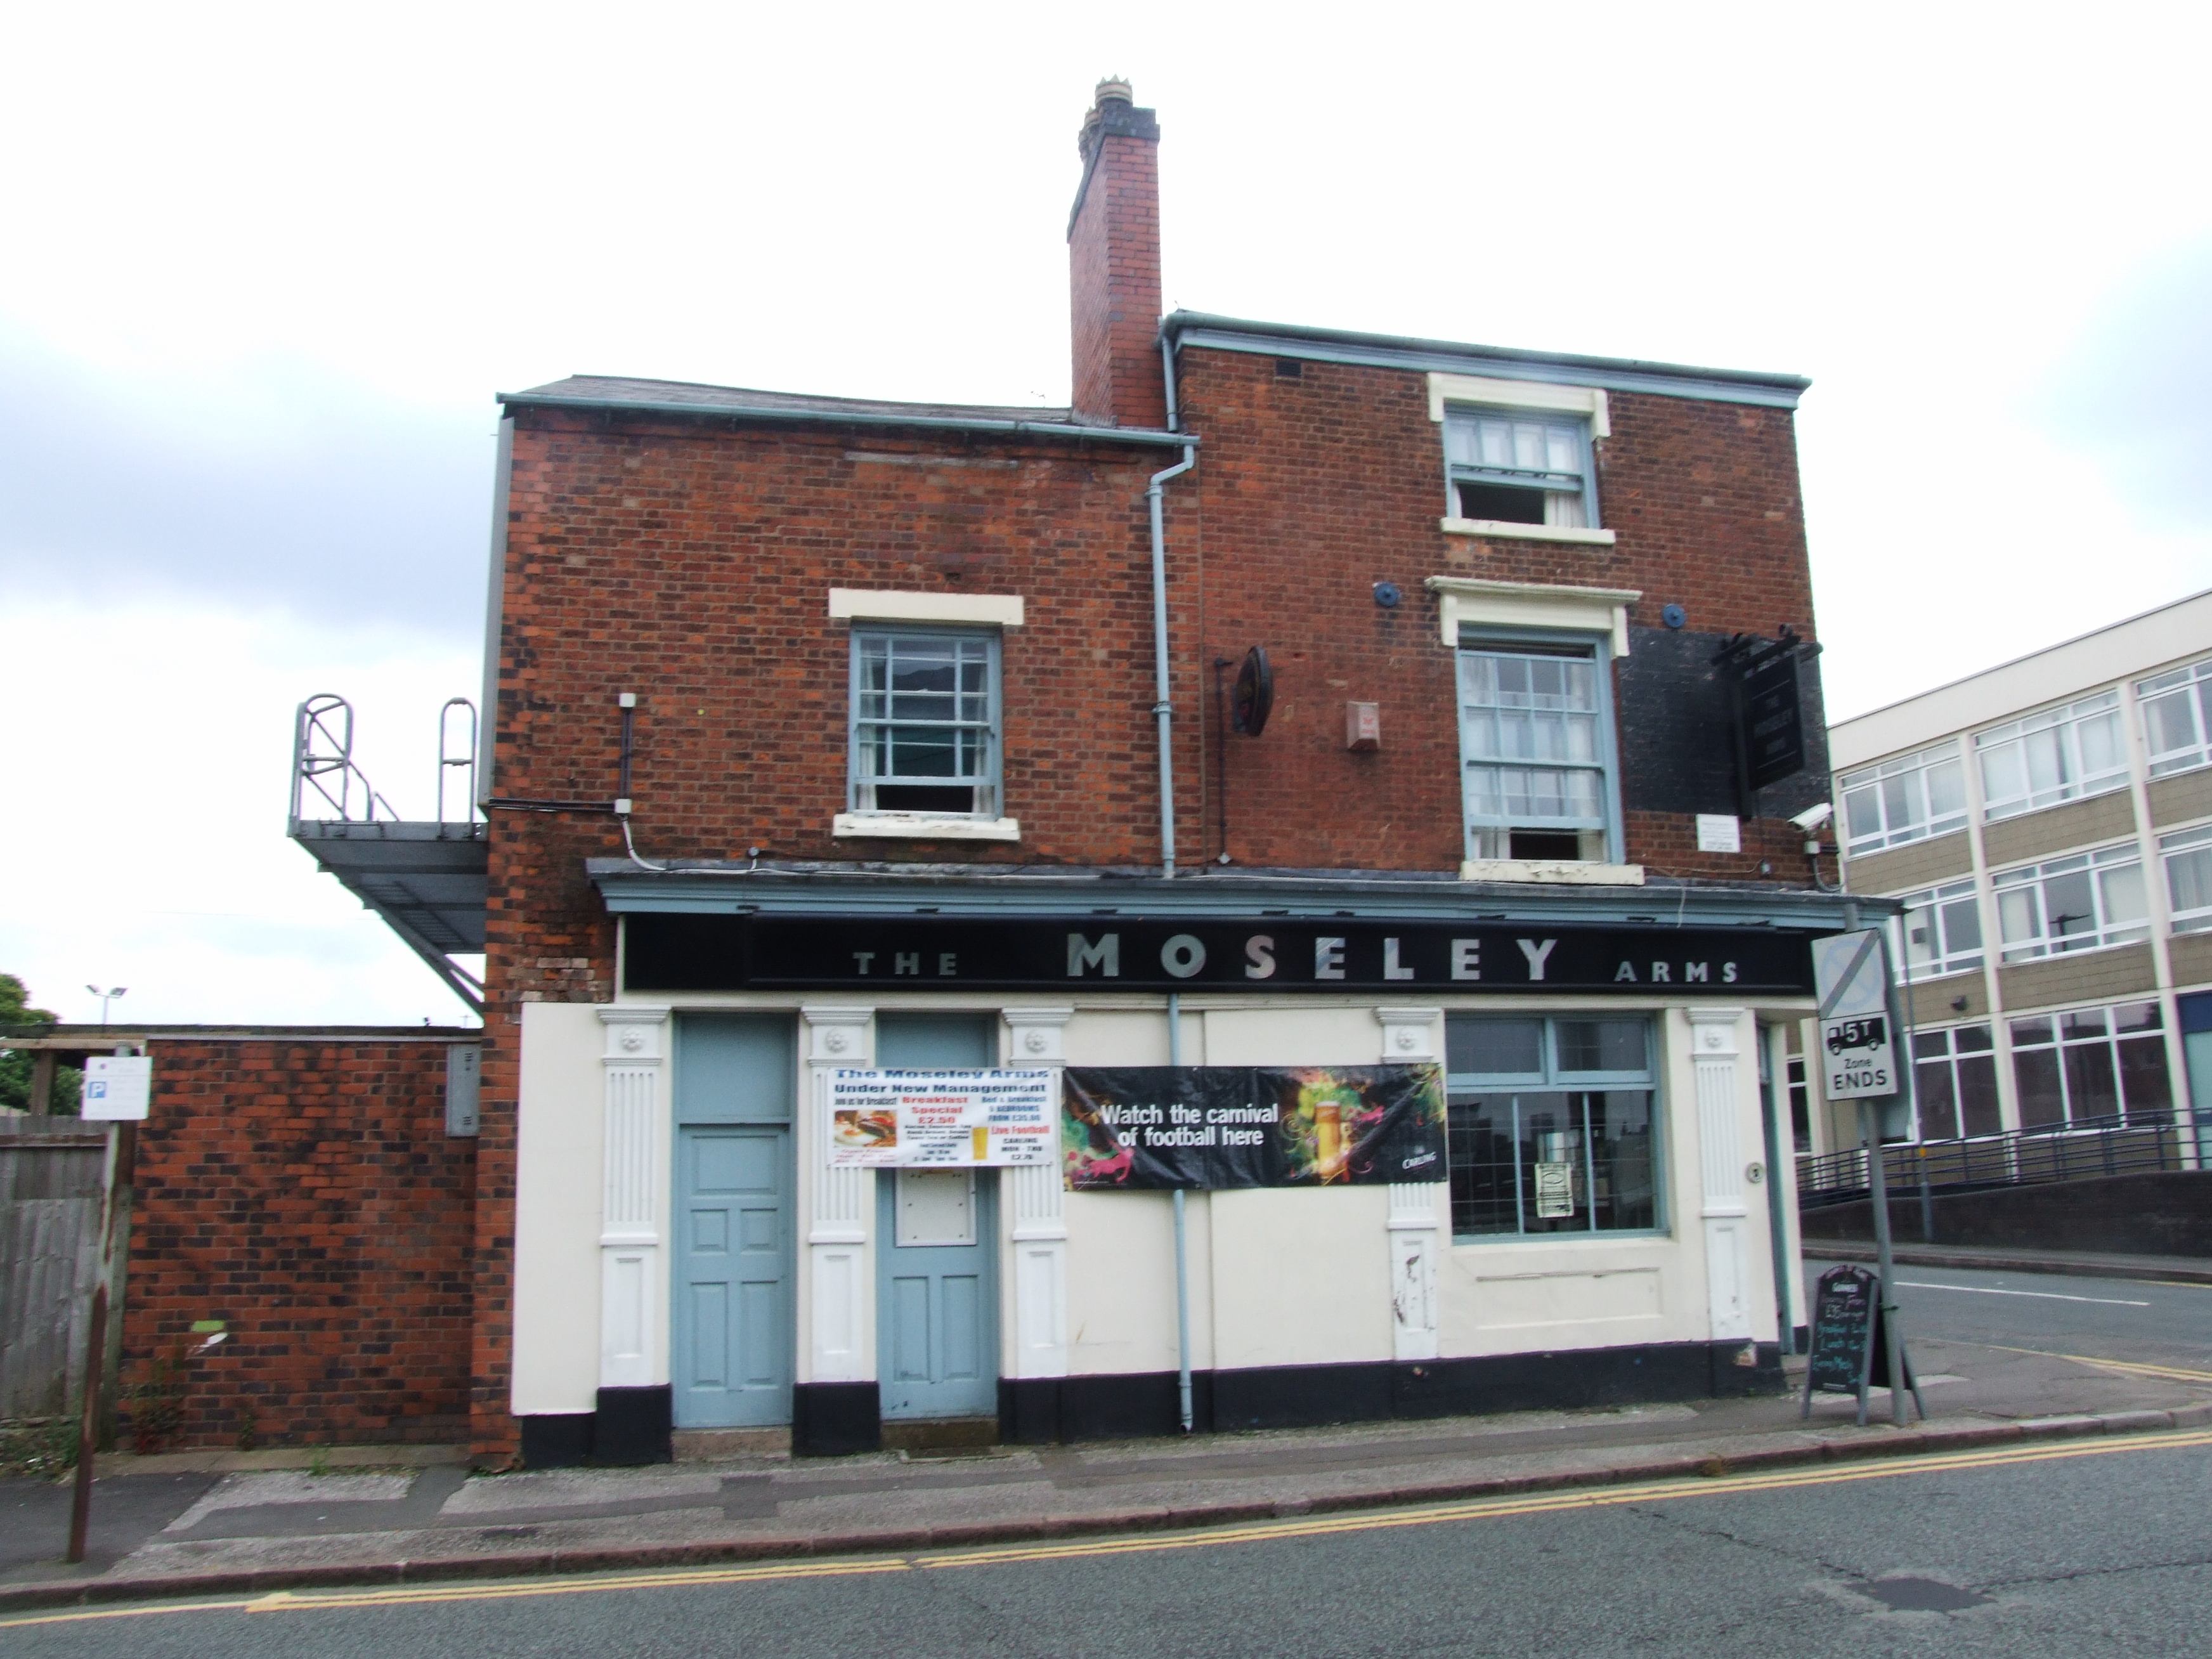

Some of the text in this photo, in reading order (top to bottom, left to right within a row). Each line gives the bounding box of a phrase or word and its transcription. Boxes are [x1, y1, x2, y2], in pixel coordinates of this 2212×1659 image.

[852, 933, 1738, 983] THE MOSELEY ARMS
[1844, 1058, 1872, 1070] Zone
[835, 1069, 1049, 1079] The Moseley Arms
[1833, 1069, 1887, 1090] ENDS
[92, 1083, 105, 1097] P
[834, 1084, 1046, 1093] Under New Management
[911, 1106, 963, 1114] Special
[1100, 1102, 1278, 1126] Watch the carnival
[1117, 1125, 1265, 1147] of football here
[1402, 1152, 1437, 1170] CARLING
